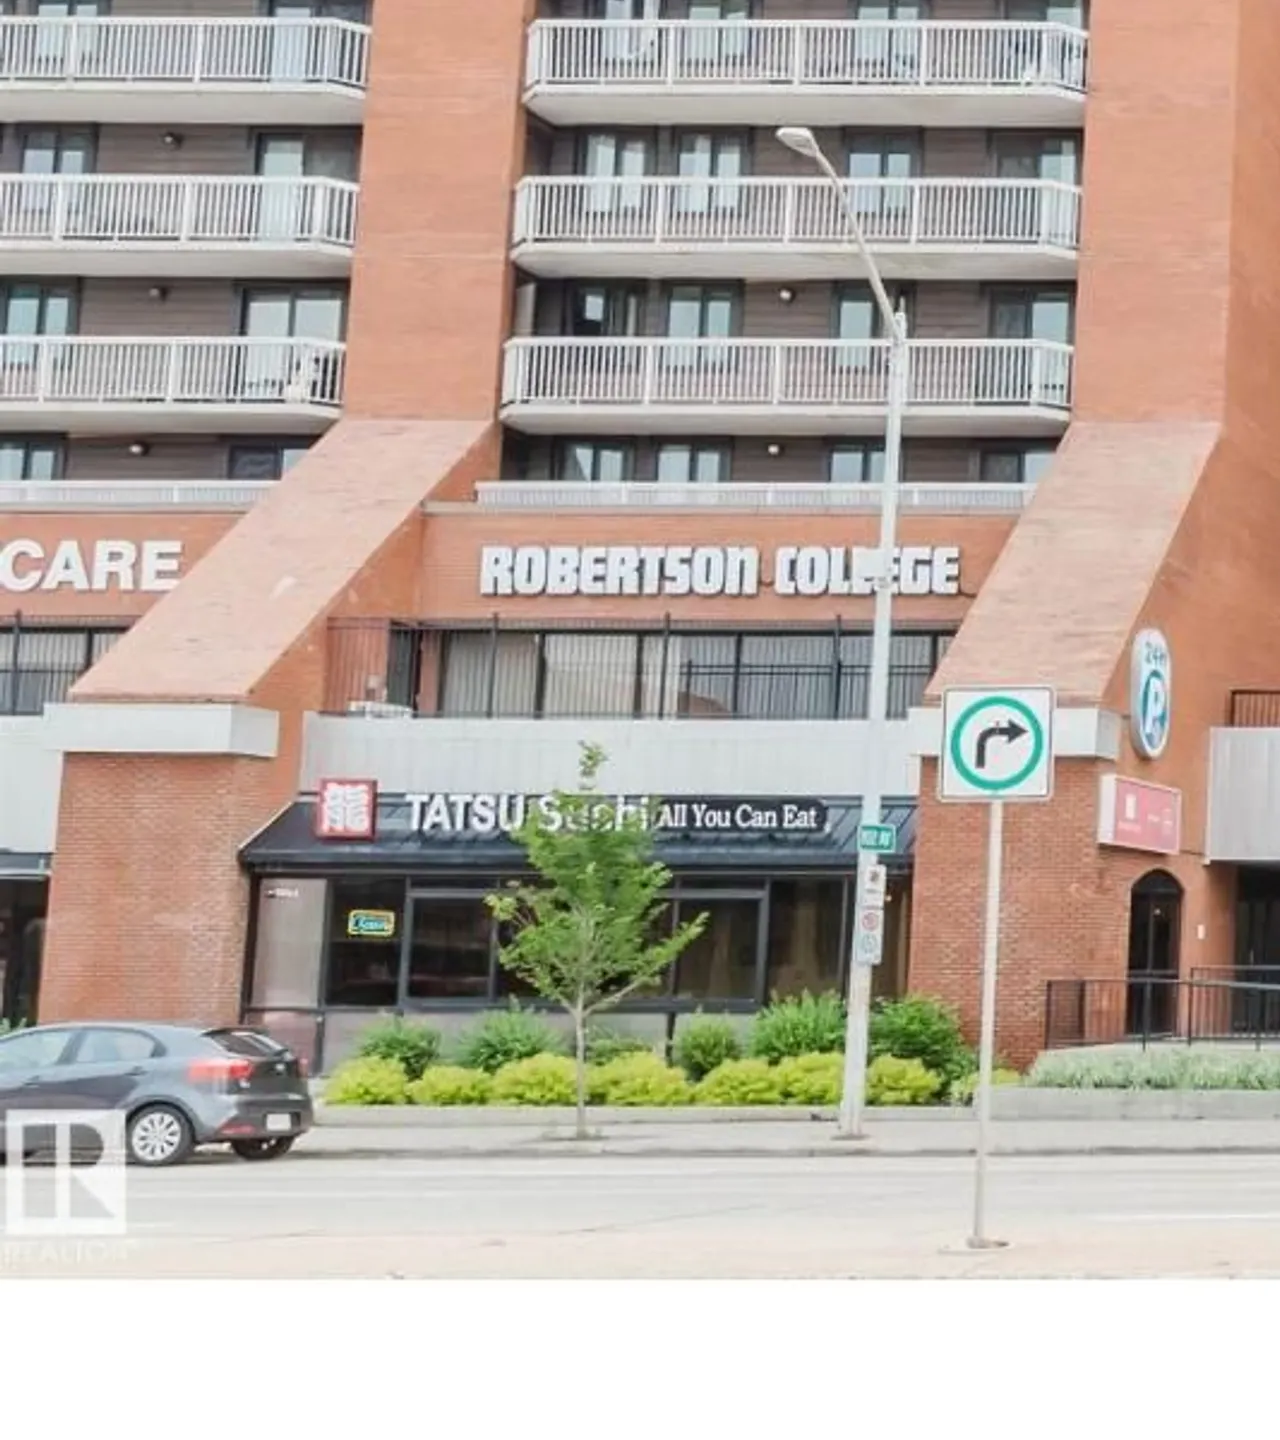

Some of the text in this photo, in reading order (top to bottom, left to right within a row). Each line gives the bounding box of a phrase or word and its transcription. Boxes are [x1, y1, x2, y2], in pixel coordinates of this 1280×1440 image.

[0, 538, 182, 593] CARE
[481, 546, 758, 595] ROBERTSON
[405, 794, 525, 832] TATSU
[657, 804, 818, 829] All You Can Eat
